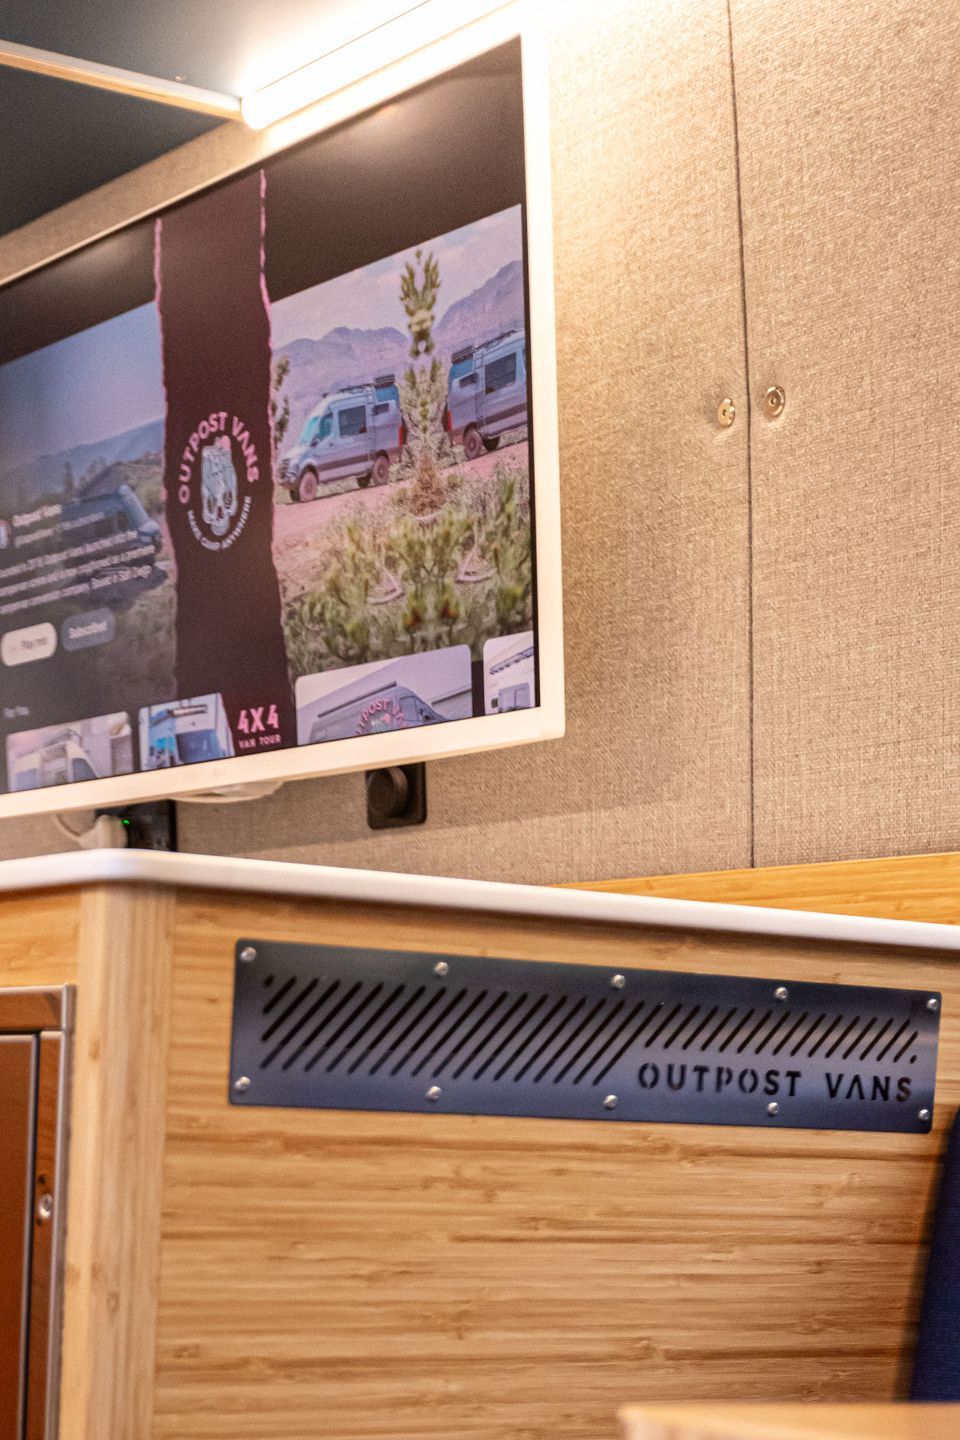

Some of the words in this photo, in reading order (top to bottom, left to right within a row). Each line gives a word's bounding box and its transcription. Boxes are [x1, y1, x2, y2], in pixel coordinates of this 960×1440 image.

[178, 411, 228, 504] OUTPOST
[232, 415, 260, 483] VANS
[638, 1062, 802, 1098] OUTPOST
[825, 1072, 912, 1102] VANS
